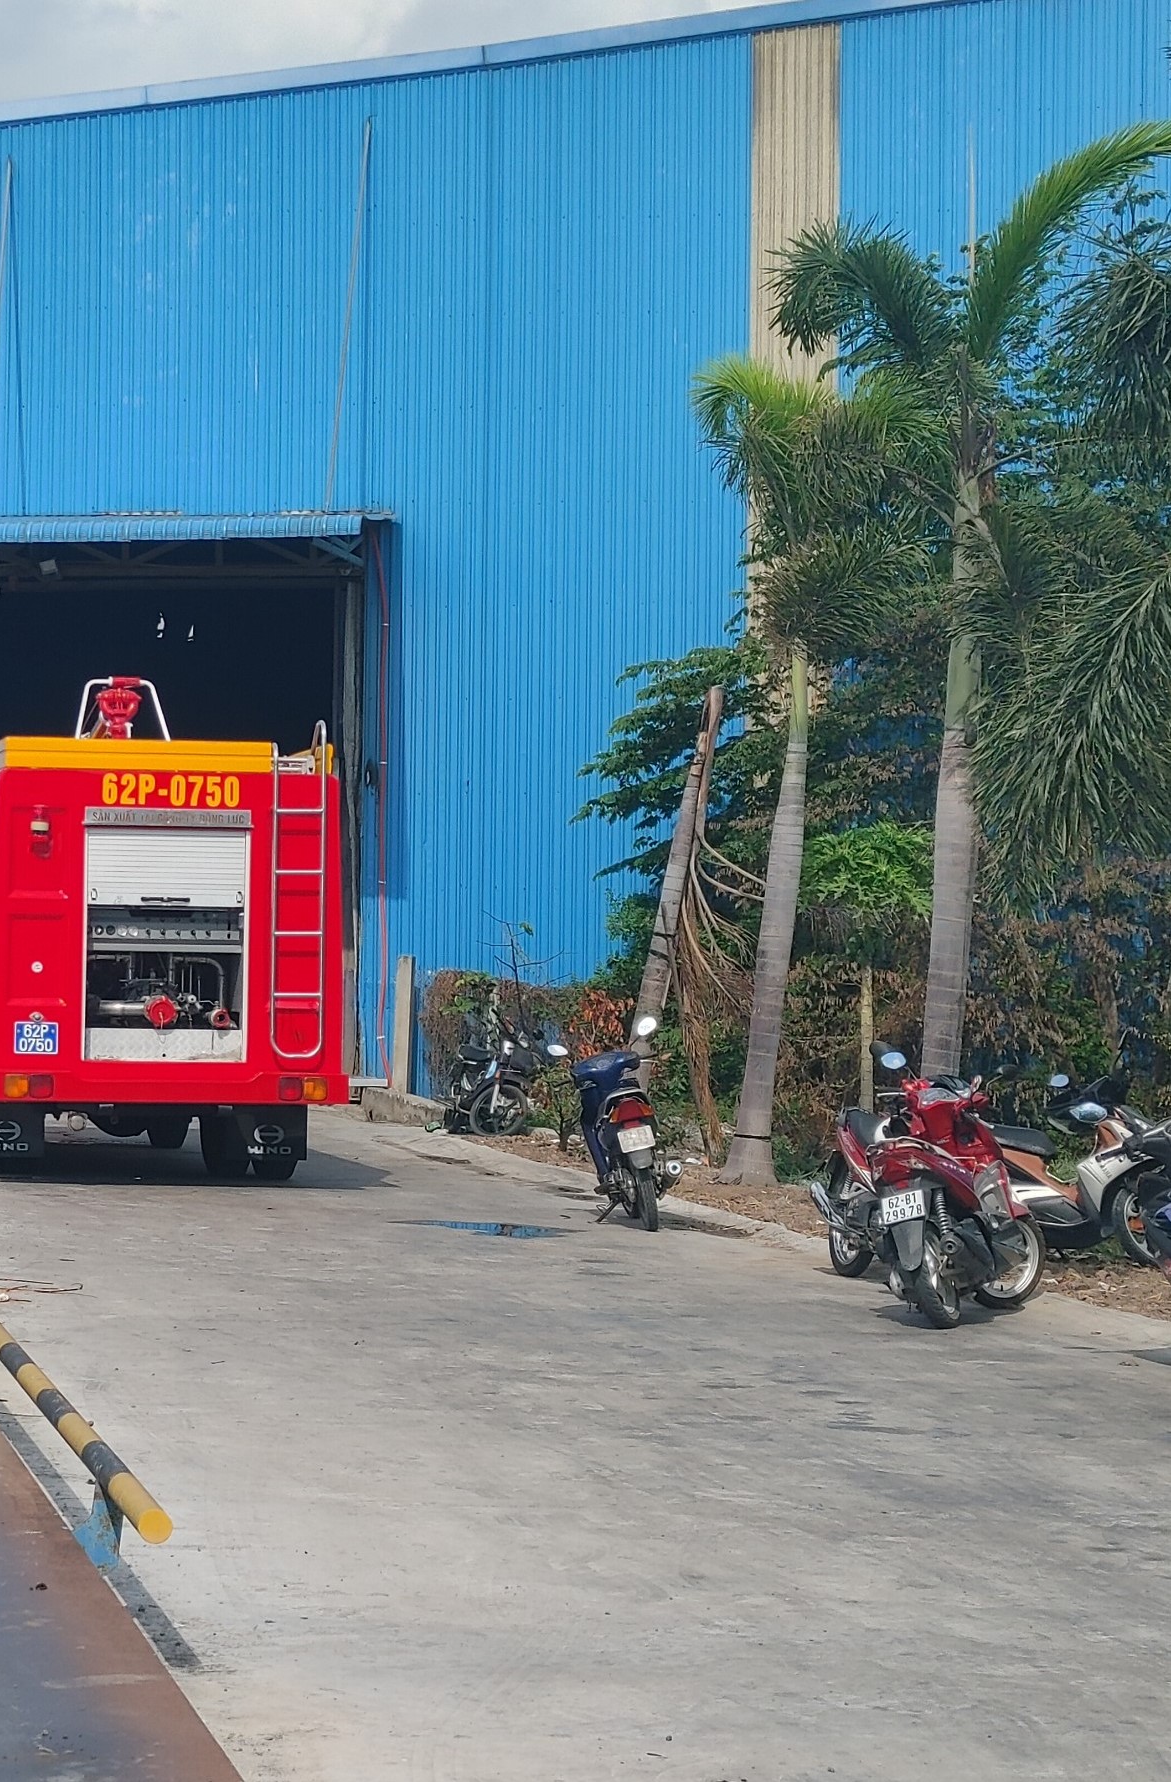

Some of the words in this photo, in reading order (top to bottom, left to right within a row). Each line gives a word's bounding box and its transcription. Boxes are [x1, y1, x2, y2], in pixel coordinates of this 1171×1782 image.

[102, 772, 240, 808] 62P-0750
[23, 1024, 49, 1038] 62P
[19, 1038, 53, 1052] 0750
[888, 1192, 917, 1209] 62-B1
[885, 1203, 923, 1223] 299.78
